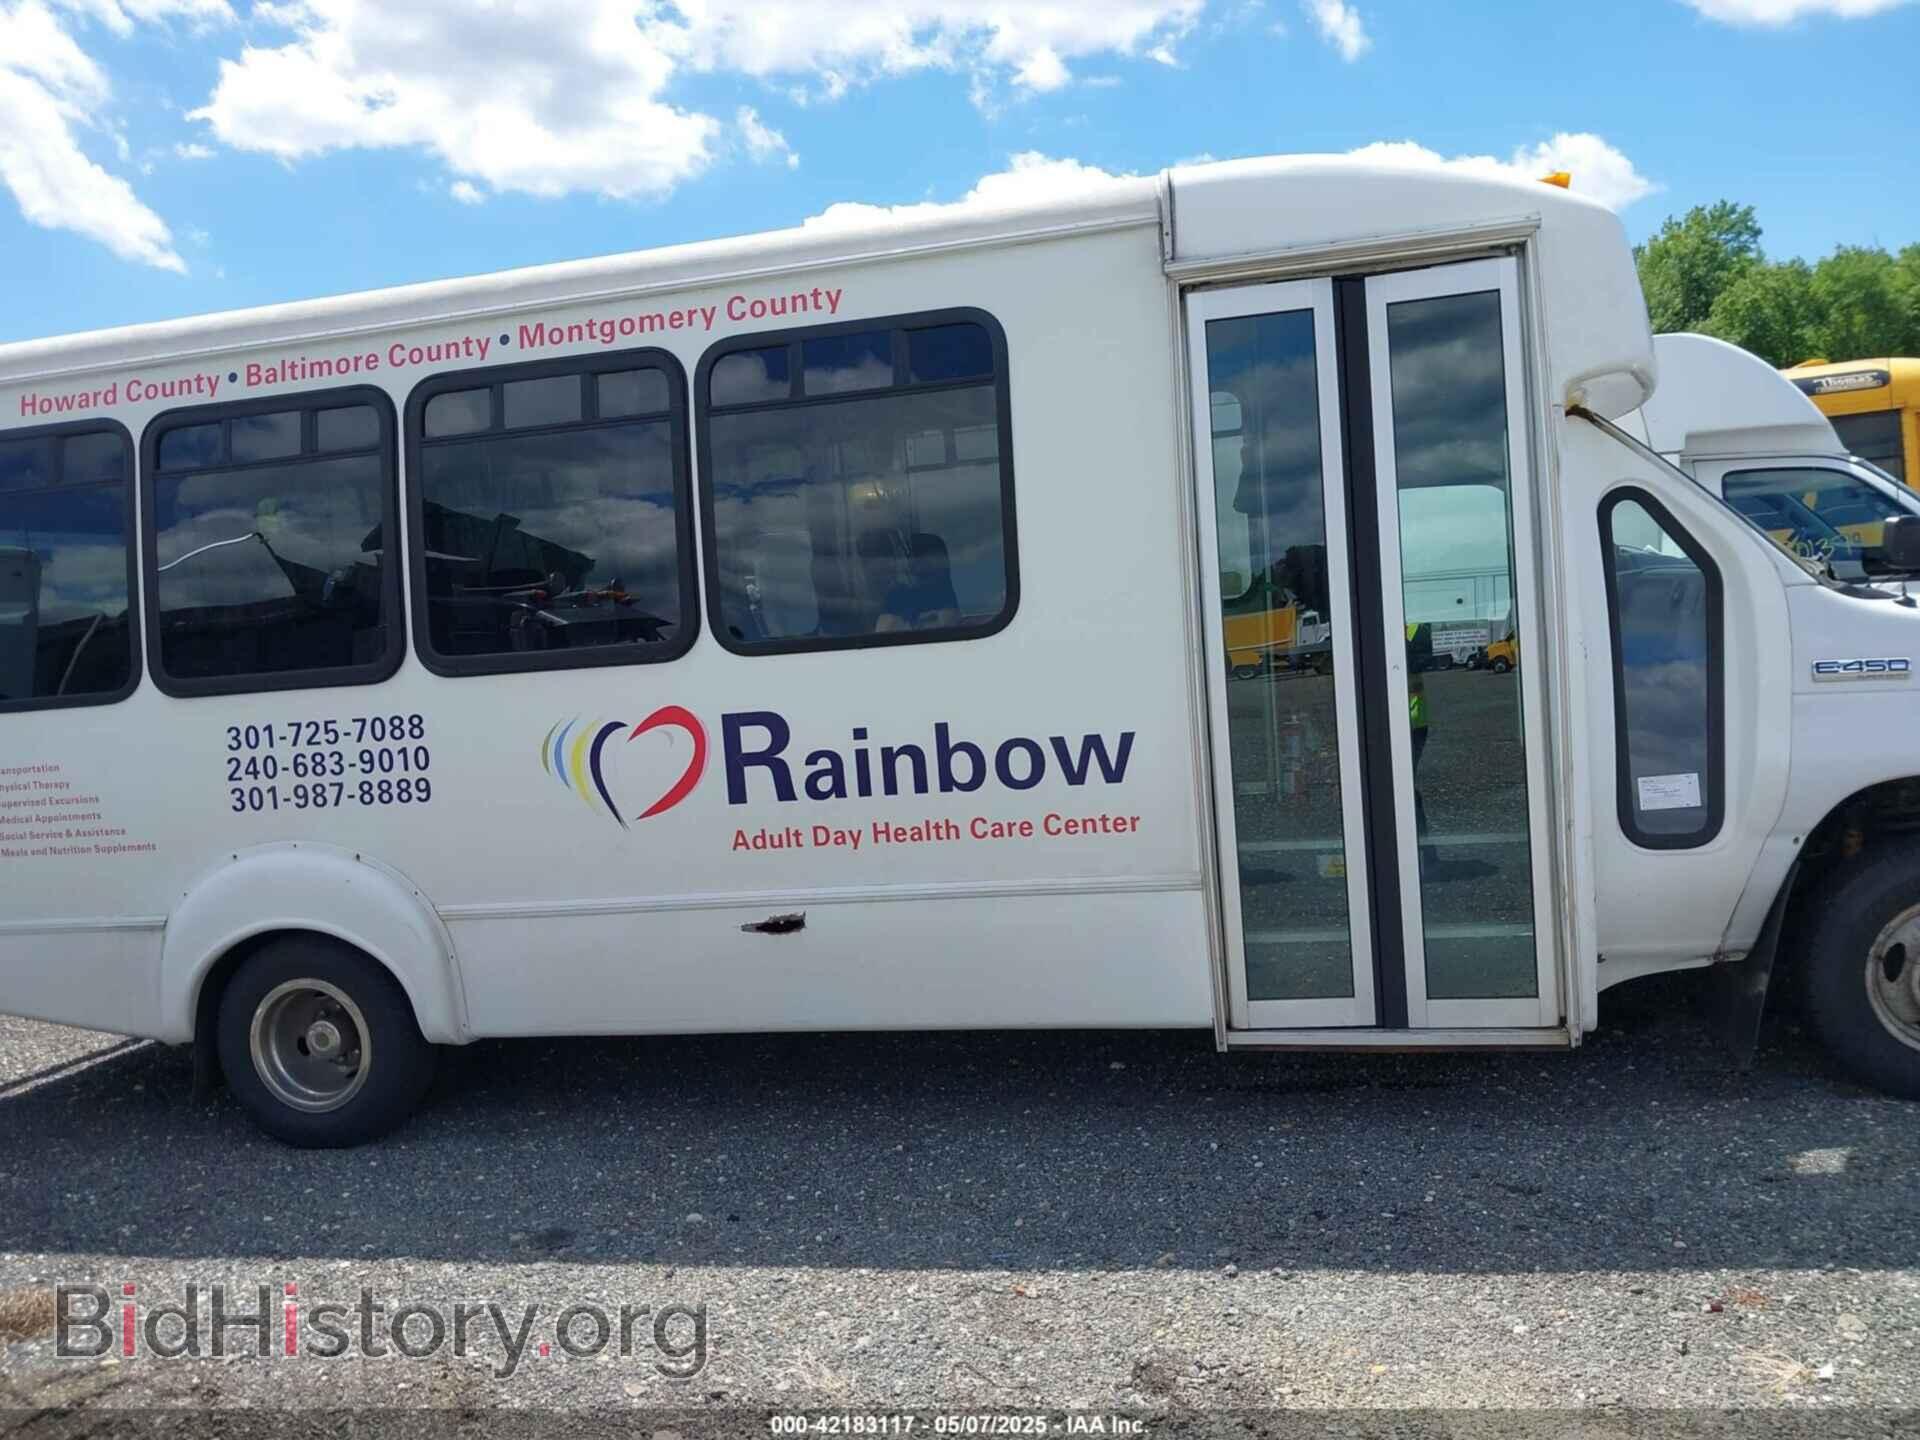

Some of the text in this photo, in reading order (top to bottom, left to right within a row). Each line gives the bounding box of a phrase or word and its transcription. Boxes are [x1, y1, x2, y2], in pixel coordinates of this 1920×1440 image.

[20, 288, 843, 417] Howard County Baltimore County Montgomery County
[227, 714, 425, 751] 301-725-7088
[227, 746, 431, 782] 240-683-9010
[721, 710, 1136, 805] Rainbow
[32, 780, 71, 791] Therapy
[231, 777, 432, 812] 301-987-8889
[30, 830, 64, 840] Service
[75, 828, 126, 838] Assistance
[35, 813, 102, 824] Appointments
[732, 812, 1141, 851] Adult Day Health Care Center
[1, 843, 157, 857] Meals and Nutrition Supplements
